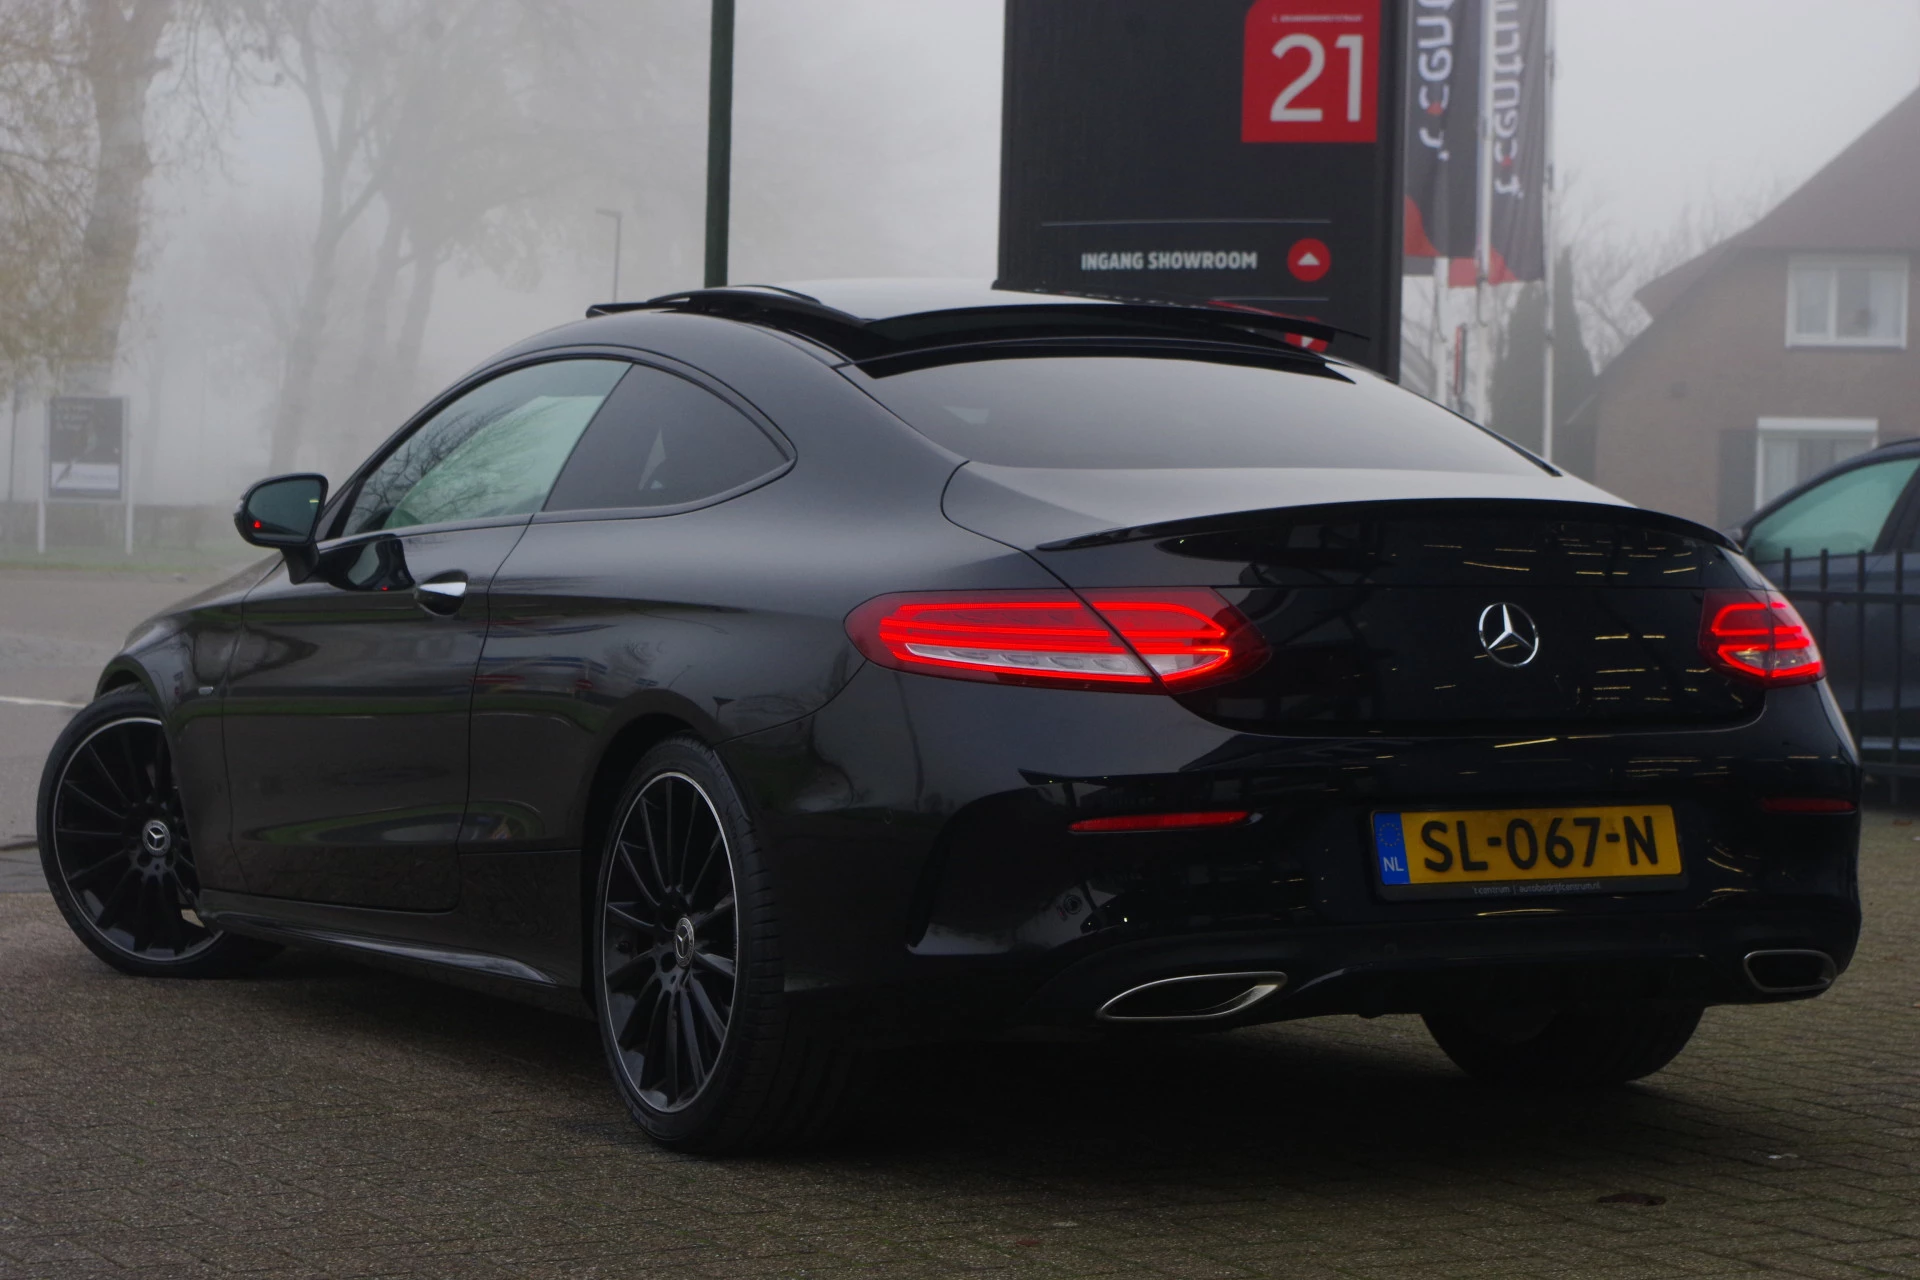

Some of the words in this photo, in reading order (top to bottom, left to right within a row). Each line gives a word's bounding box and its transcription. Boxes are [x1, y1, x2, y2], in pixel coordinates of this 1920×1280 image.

[1270, 32, 1364, 122] 21
[1081, 252, 1144, 271] INGANG
[1147, 251, 1258, 270] SHOWROOM
[1420, 815, 1659, 873] SL-067-N
[1383, 856, 1404, 873] NL
